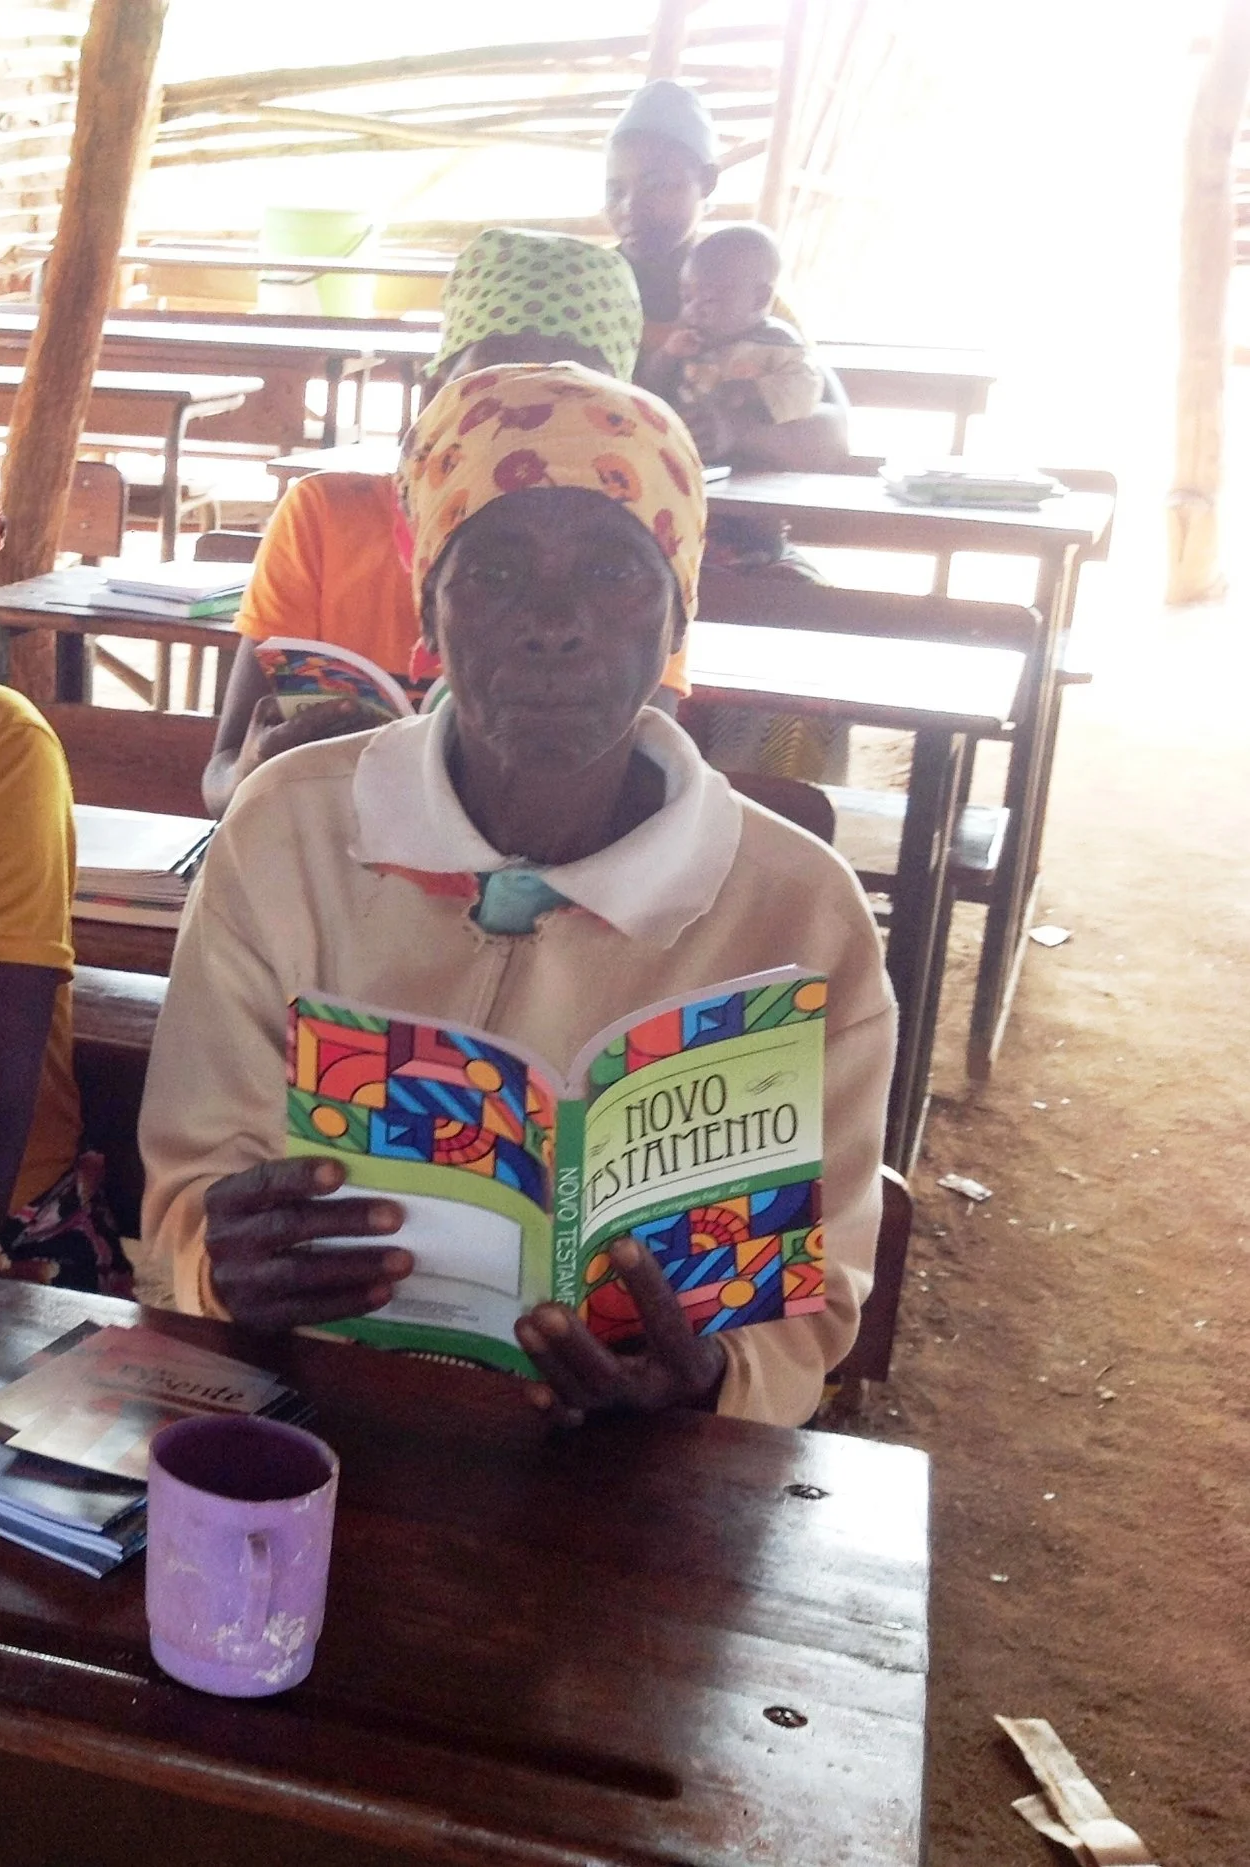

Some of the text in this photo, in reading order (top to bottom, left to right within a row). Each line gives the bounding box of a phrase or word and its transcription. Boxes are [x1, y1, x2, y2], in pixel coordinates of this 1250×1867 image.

[625, 1073, 728, 1144] NOVO
[554, 1166, 581, 1308] NOVO TESTAME
